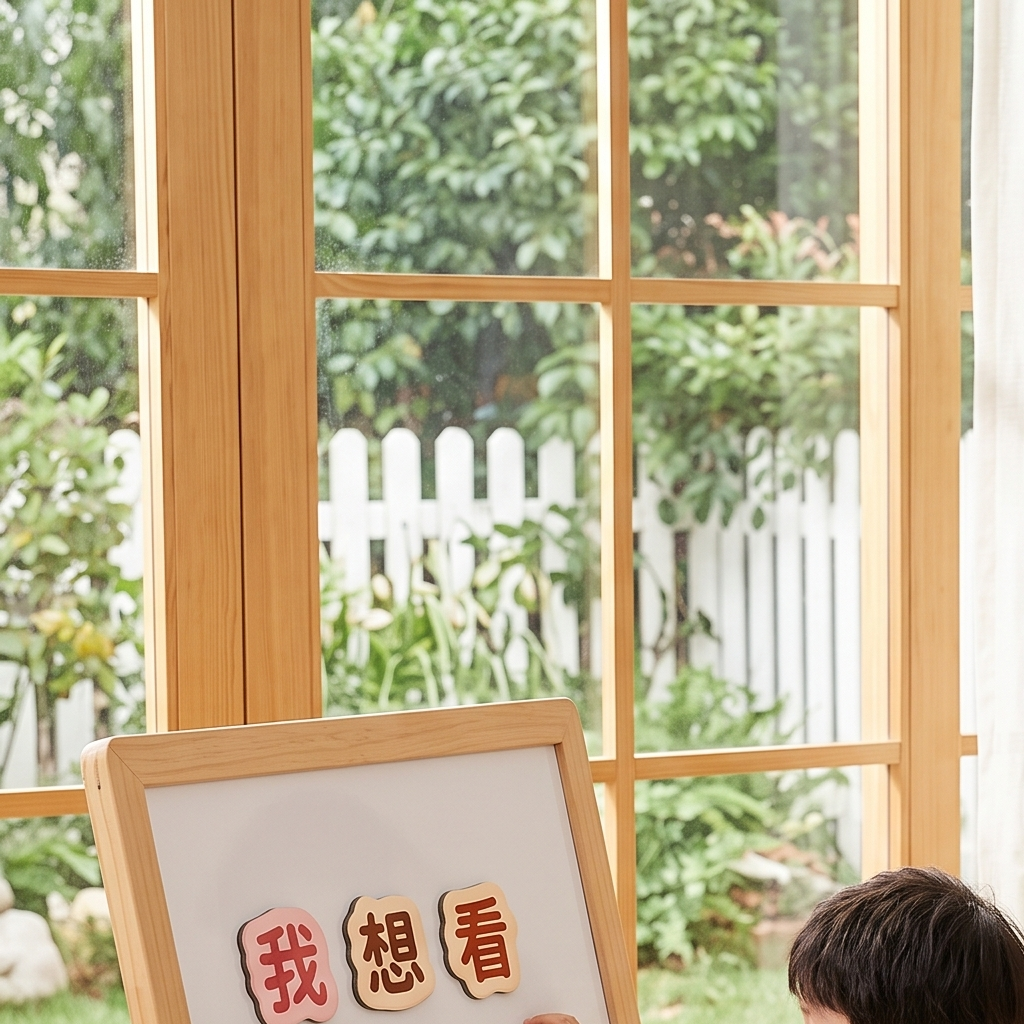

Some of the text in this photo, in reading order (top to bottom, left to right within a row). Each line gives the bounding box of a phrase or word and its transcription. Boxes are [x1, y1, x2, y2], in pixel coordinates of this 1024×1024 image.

[256, 896, 511, 1014] 我 想 看
